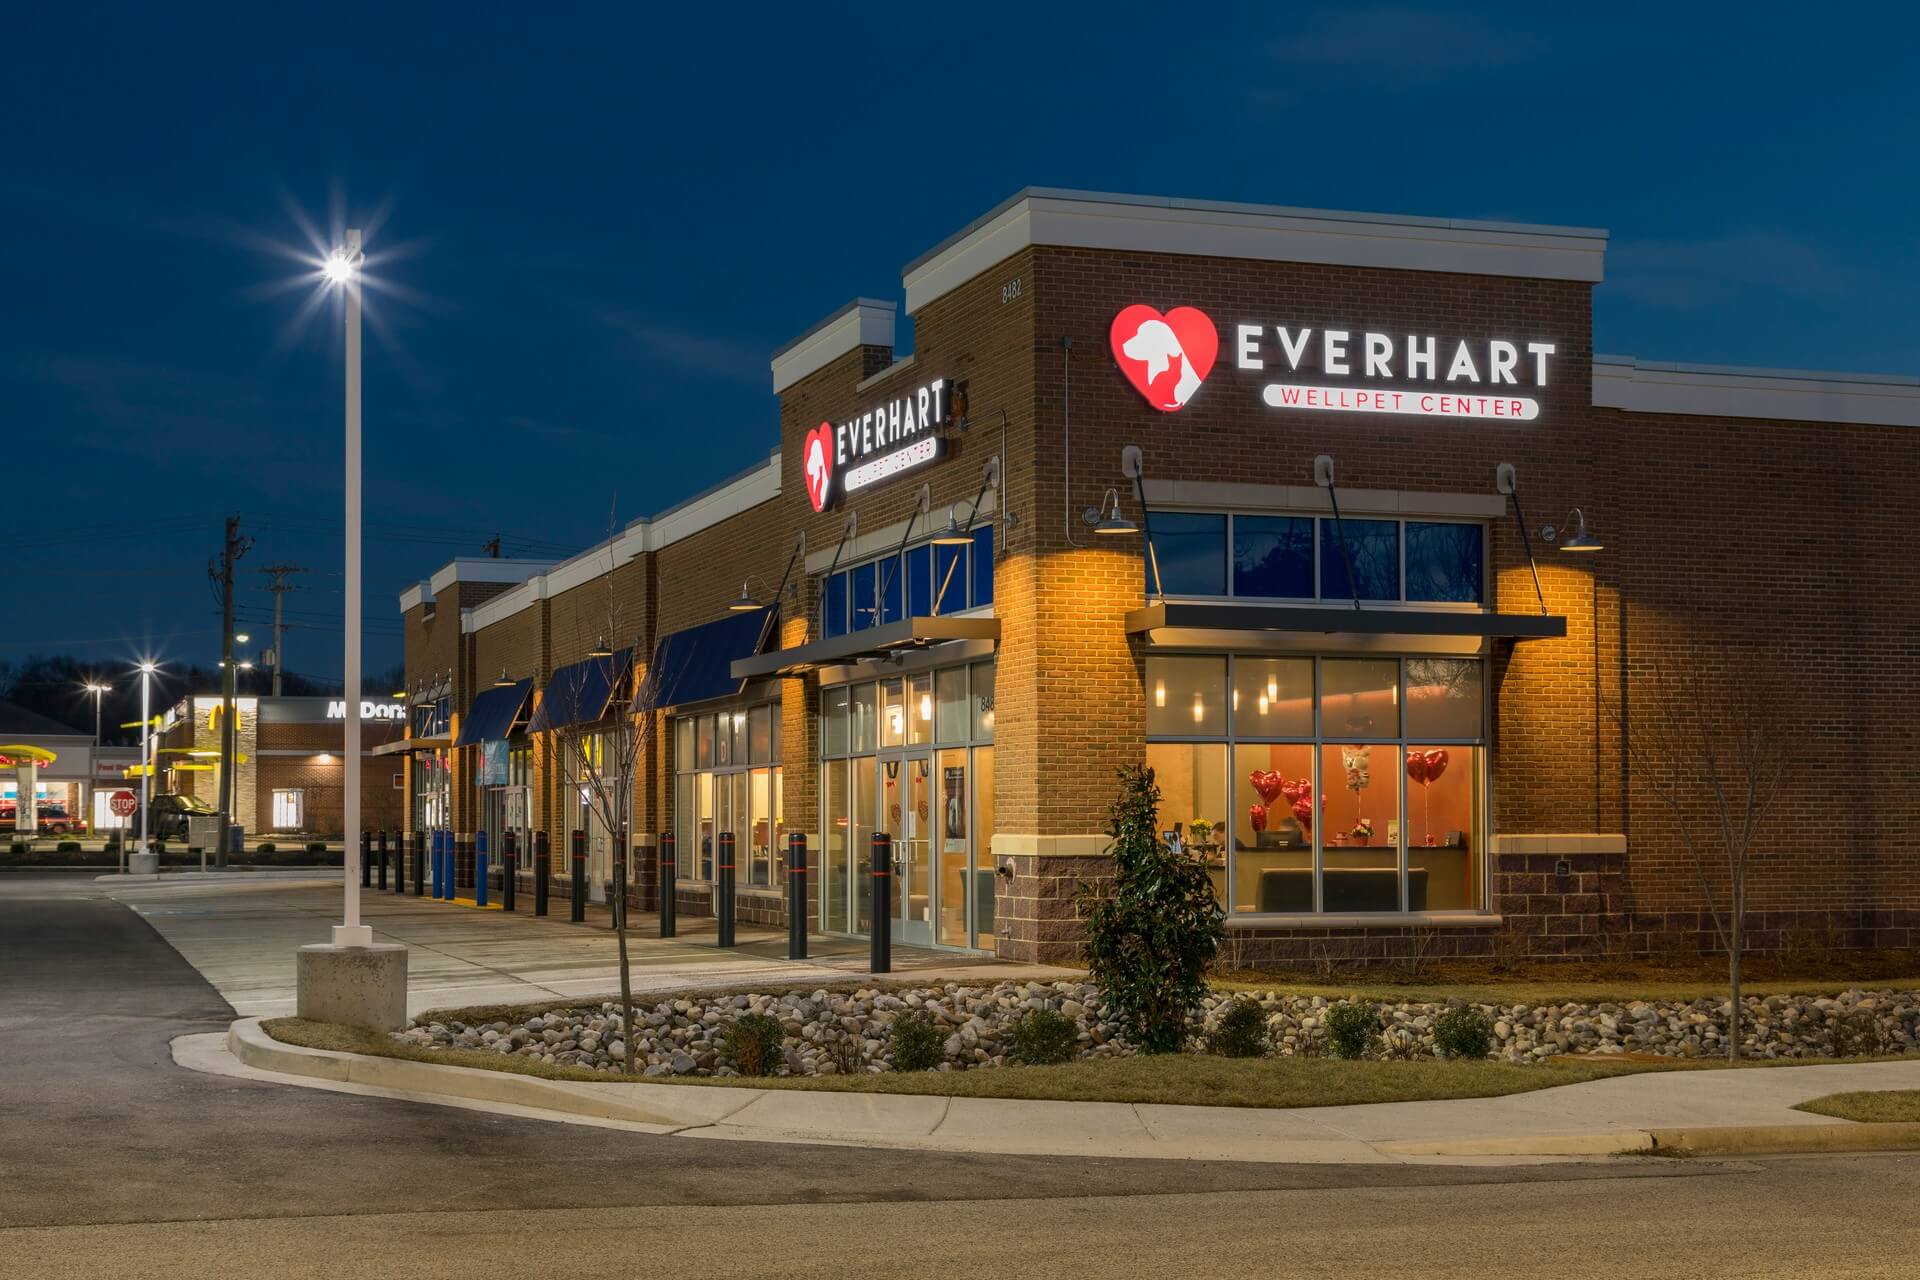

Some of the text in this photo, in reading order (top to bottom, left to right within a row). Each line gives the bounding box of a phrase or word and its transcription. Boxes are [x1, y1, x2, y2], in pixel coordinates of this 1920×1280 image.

[1002, 278, 1022, 304] 8482
[1238, 325, 1555, 386] EVERHART
[1281, 388, 1523, 417] WELLPET CENTER
[837, 379, 943, 465] EVERHART
[327, 701, 406, 719] MDon
[981, 695, 994, 711] 848
[110, 798, 135, 810] STOP
